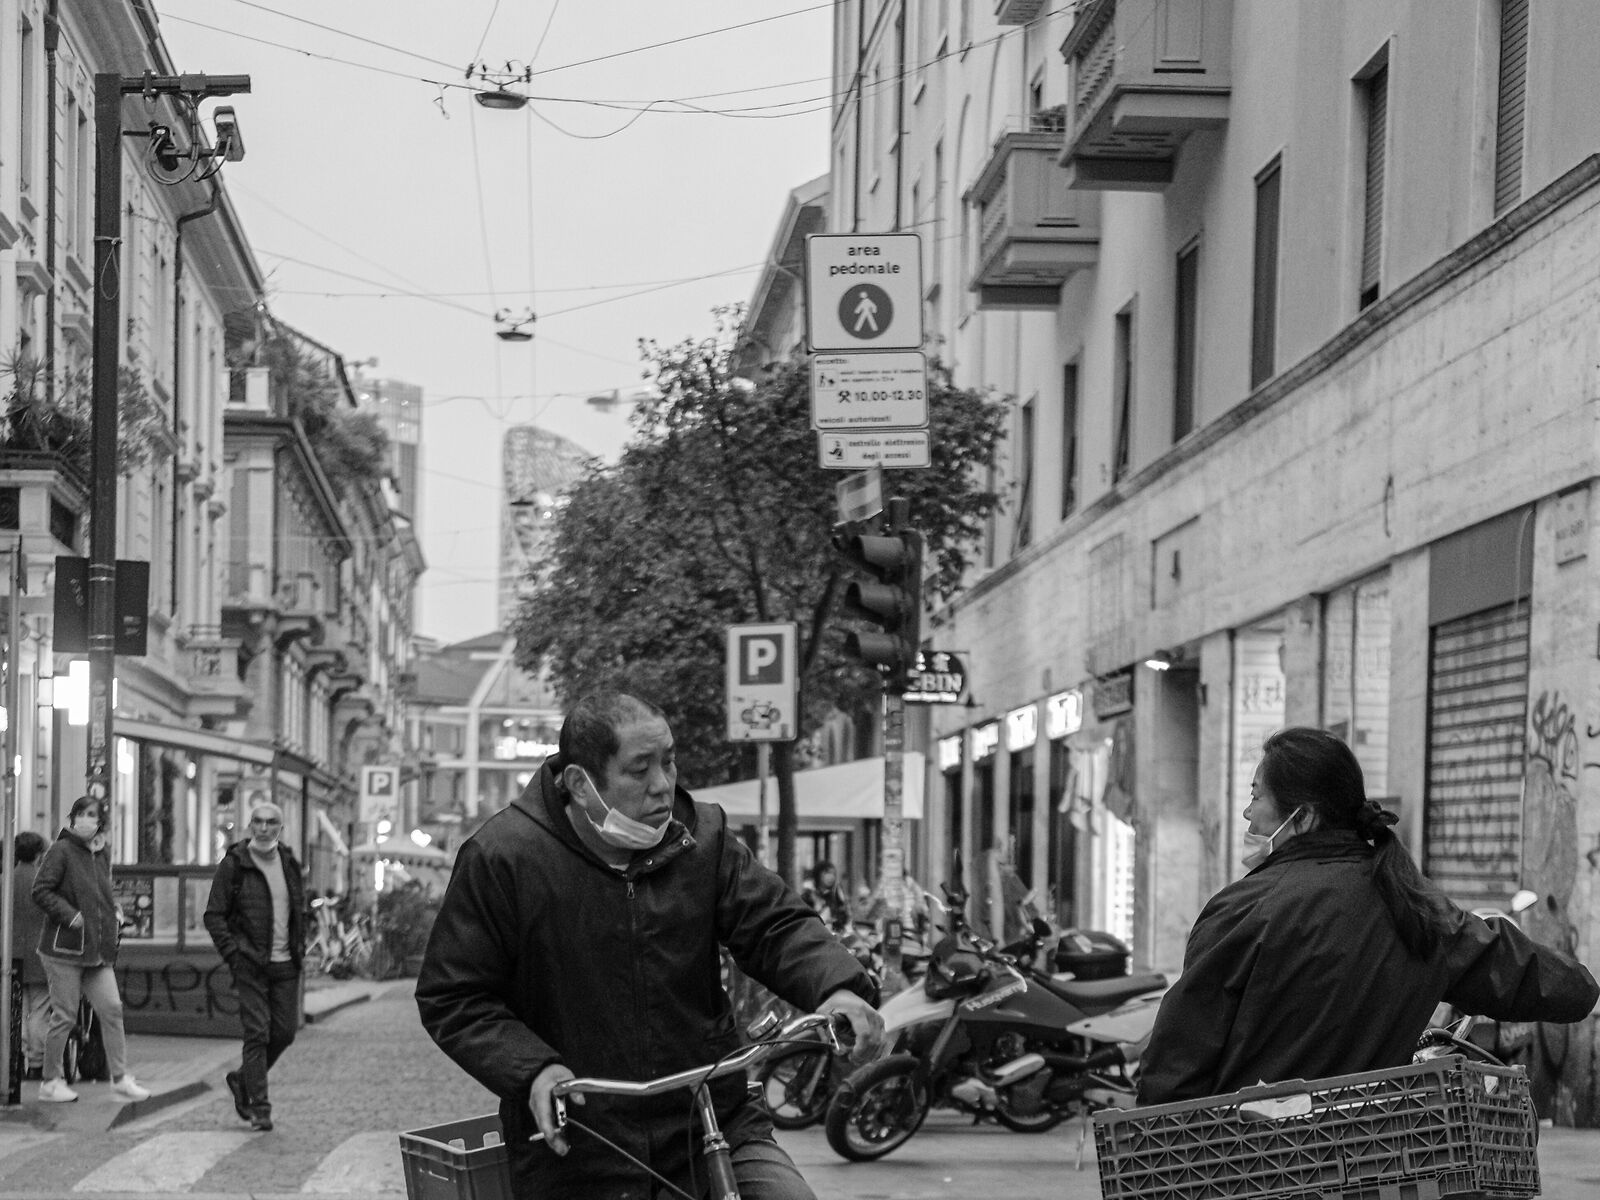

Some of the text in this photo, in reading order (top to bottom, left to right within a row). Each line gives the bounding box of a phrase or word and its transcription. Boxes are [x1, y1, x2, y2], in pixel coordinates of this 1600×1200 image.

[848, 246, 880, 256] area
[829, 262, 900, 277] pedonale
[748, 639, 777, 676] P
[372, 773, 389, 793] P
